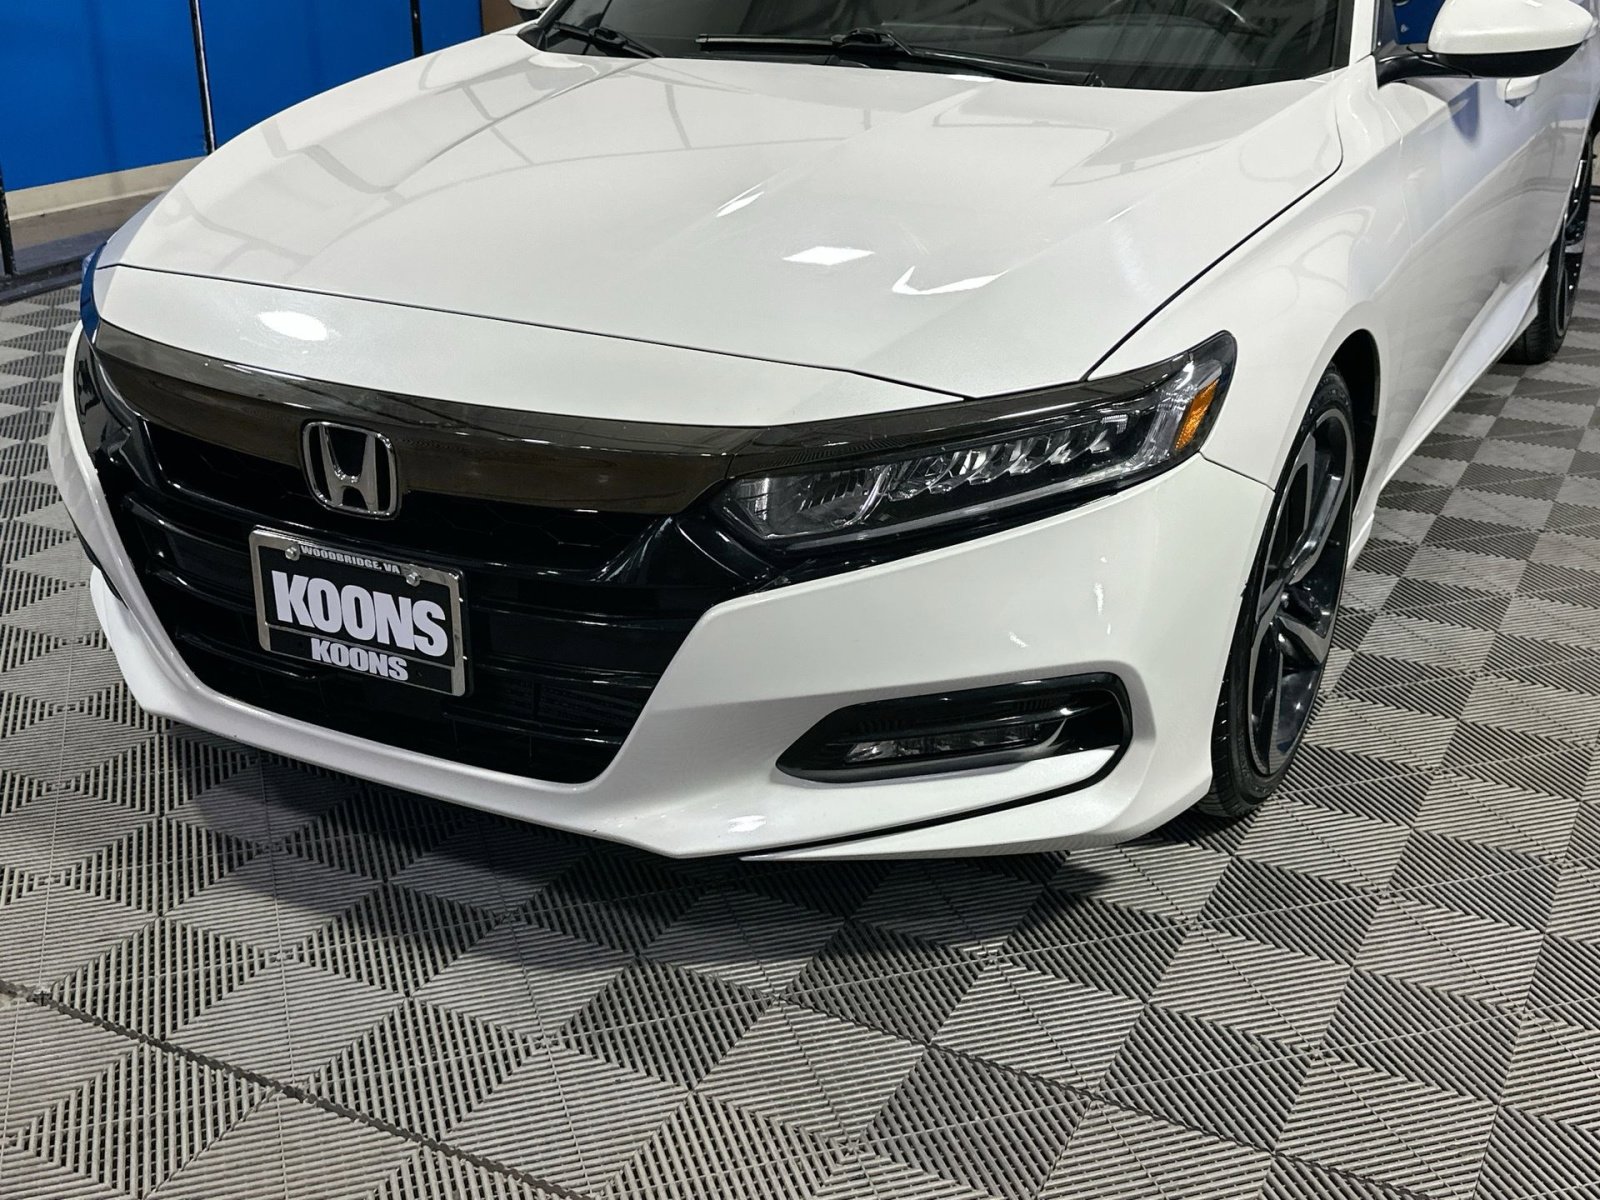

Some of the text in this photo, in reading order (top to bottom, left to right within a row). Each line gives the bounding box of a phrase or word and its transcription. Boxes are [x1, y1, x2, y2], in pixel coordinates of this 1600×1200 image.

[382, 562, 401, 574] VA
[271, 570, 448, 657] KOONS
[311, 637, 409, 681] KOONS
